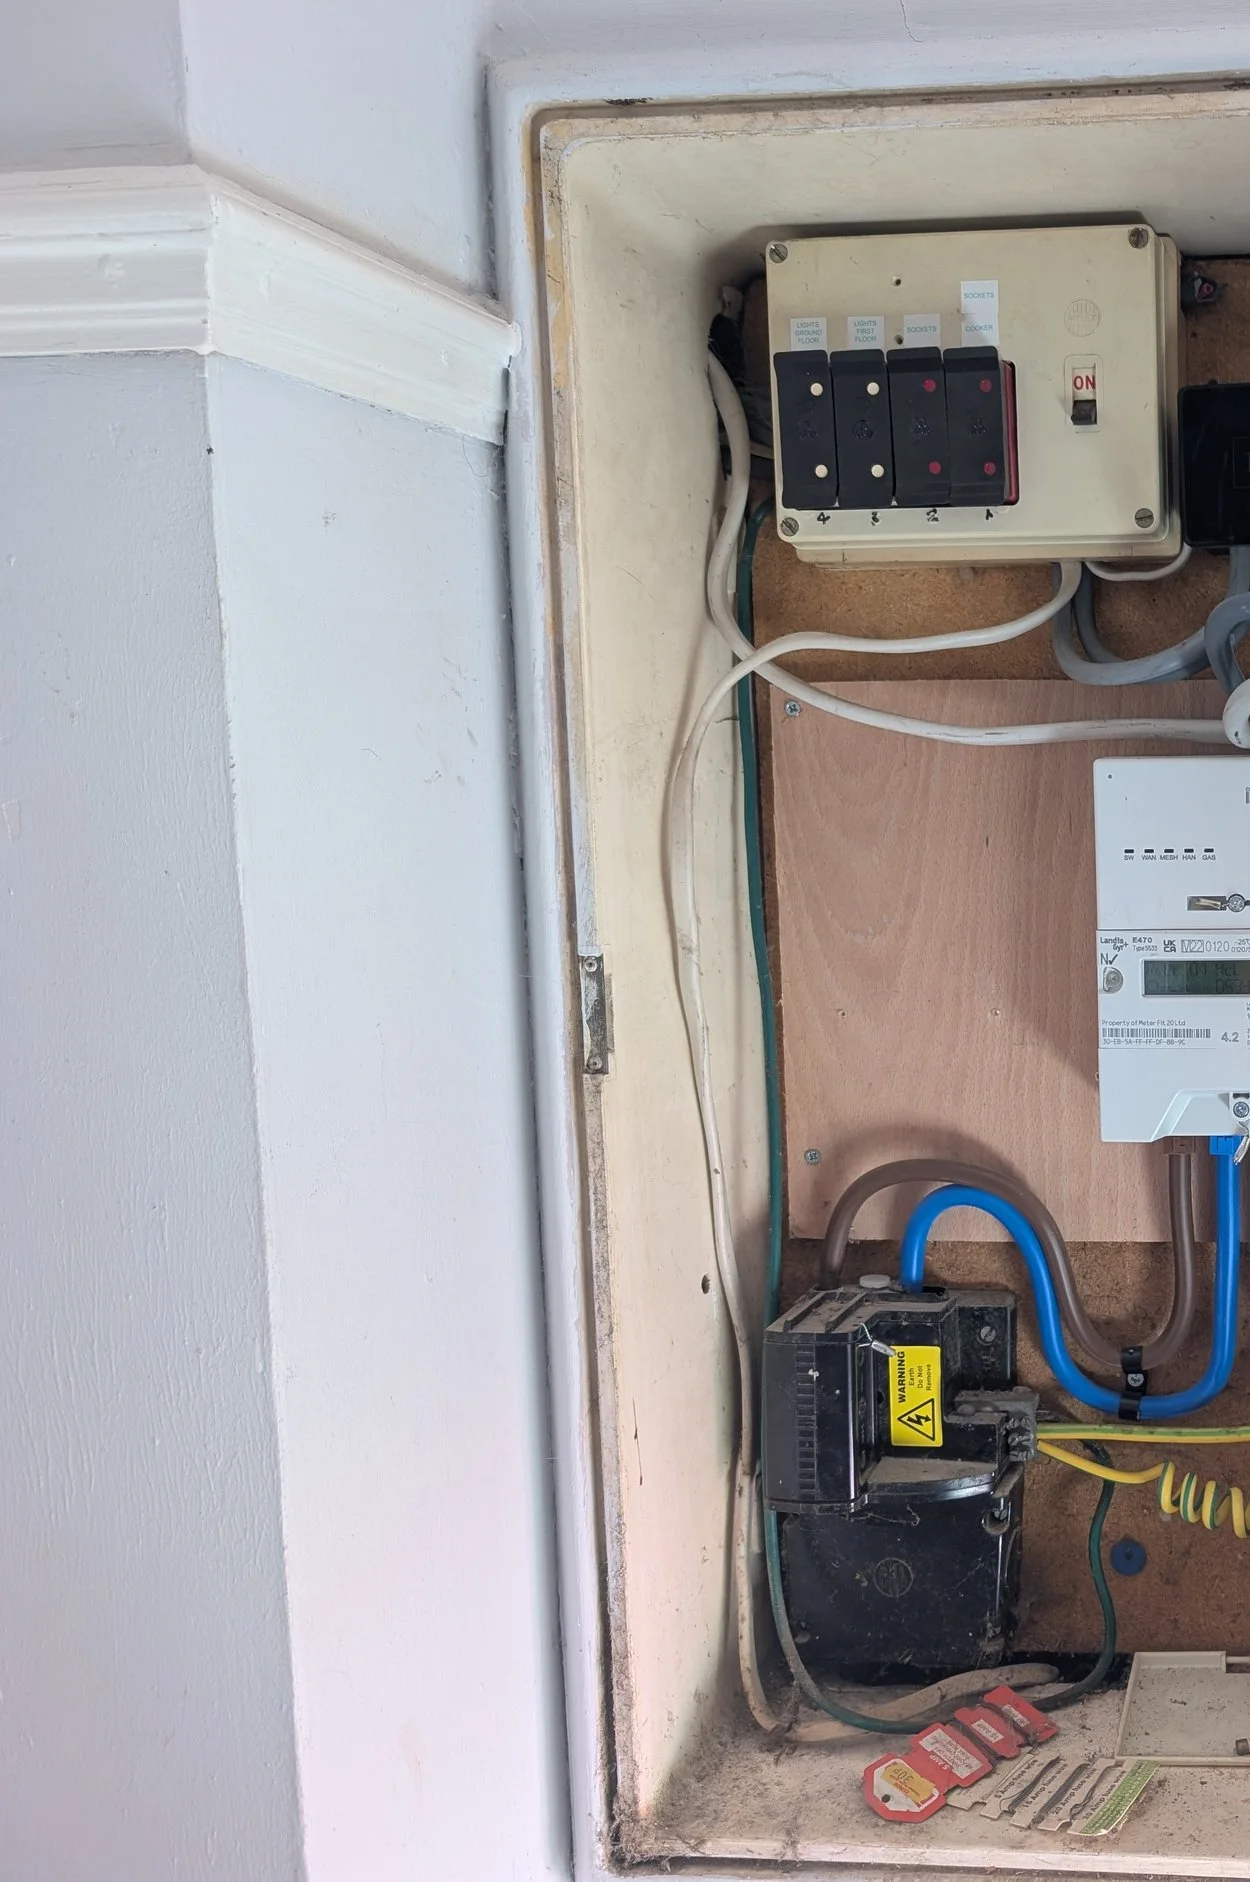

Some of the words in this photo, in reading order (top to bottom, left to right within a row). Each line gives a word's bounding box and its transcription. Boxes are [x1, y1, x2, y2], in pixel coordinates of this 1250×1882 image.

[965, 324, 993, 332] COOKER
[1073, 375, 1096, 390] ON
[1206, 941, 1230, 952] 0120
[1221, 1032, 1239, 1042] 4.2
[898, 1351, 906, 1403] WARNING
[917, 1380, 923, 1388] Do
[927, 1752, 944, 1766] AMP
[1001, 1782, 1015, 1794] Amp
[1013, 1771, 1026, 1783] fuse
[1025, 1760, 1038, 1770] wire
[1032, 1786, 1046, 1800] Amp
[1045, 1775, 1057, 1786] fuse
[1055, 1764, 1068, 1775] wire
[1052, 1807, 1062, 1815] 20
[1062, 1791, 1075, 1806] Amp
[1075, 1779, 1086, 1792] fuse
[1086, 1768, 1098, 1779] wire
[1092, 1797, 1106, 1812] Amp
[1104, 1784, 1116, 1796] fuse
[1114, 1770, 1126, 1784] wire
